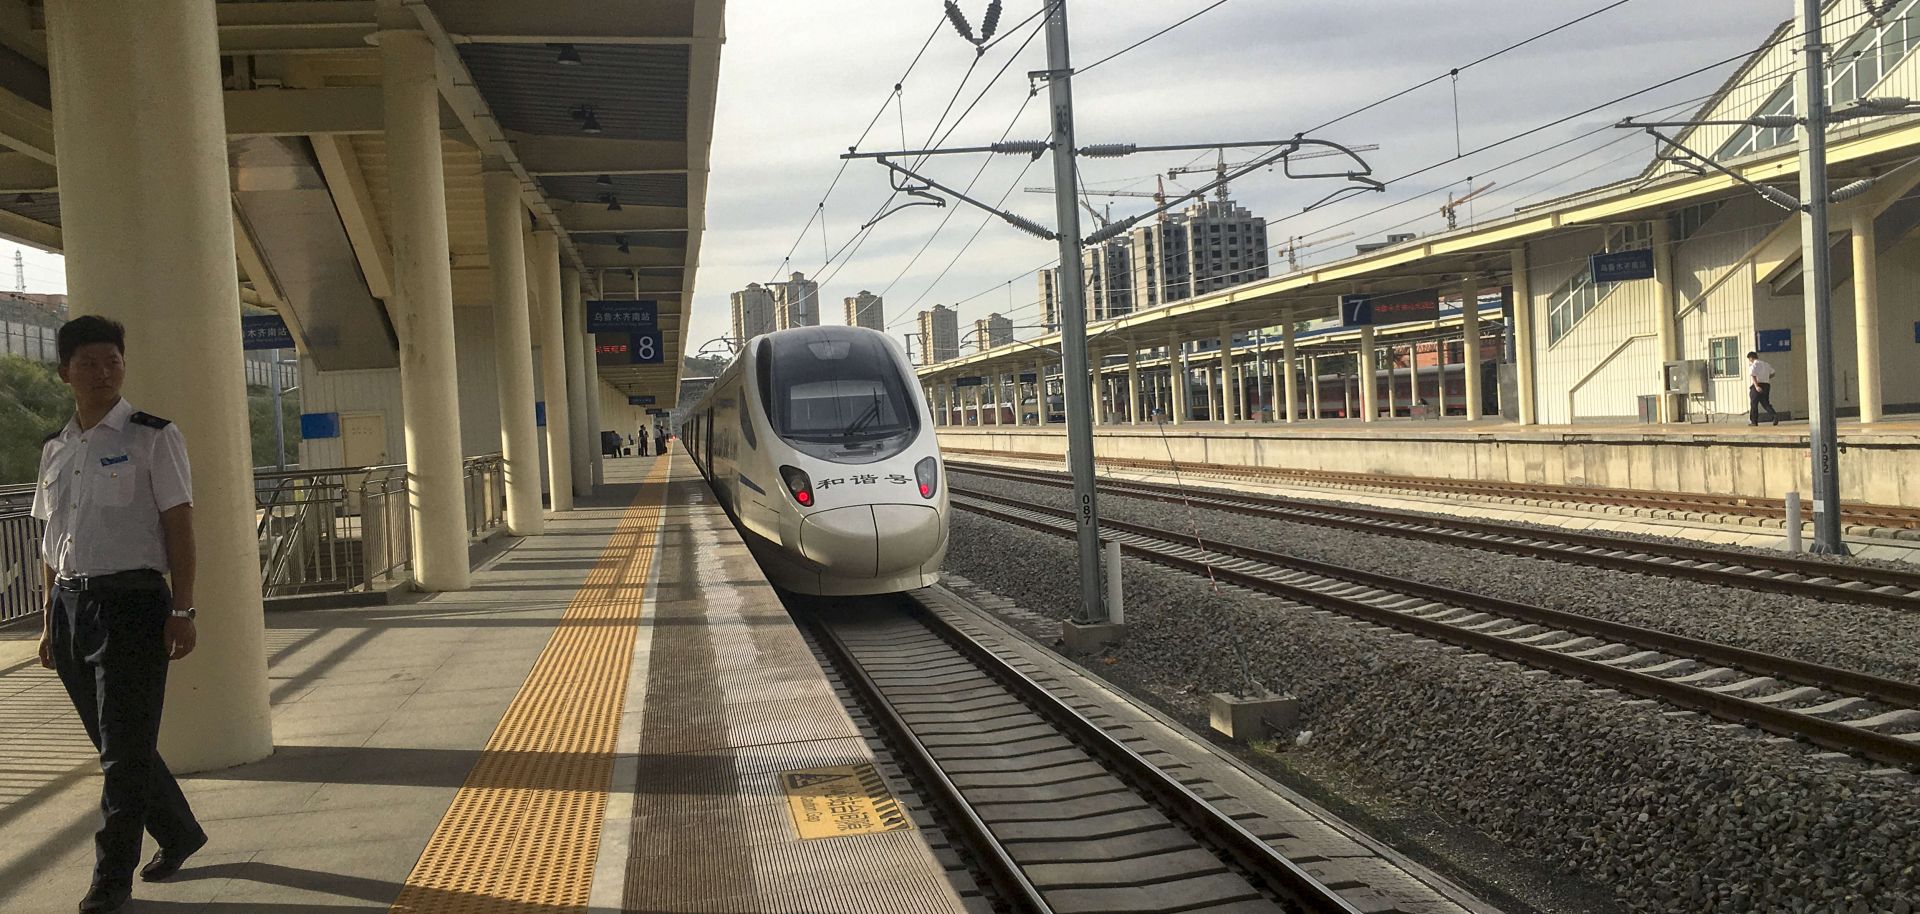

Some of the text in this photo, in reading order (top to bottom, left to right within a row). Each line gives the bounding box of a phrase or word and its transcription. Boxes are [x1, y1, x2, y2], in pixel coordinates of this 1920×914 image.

[595, 312, 650, 321] 乌鲁木齐南站
[1349, 300, 1363, 321] 7
[639, 336, 655, 360] 8
[816, 474, 912, 489] 和谐号
[1082, 494, 1091, 525] 087
[804, 811, 823, 822] Gap
